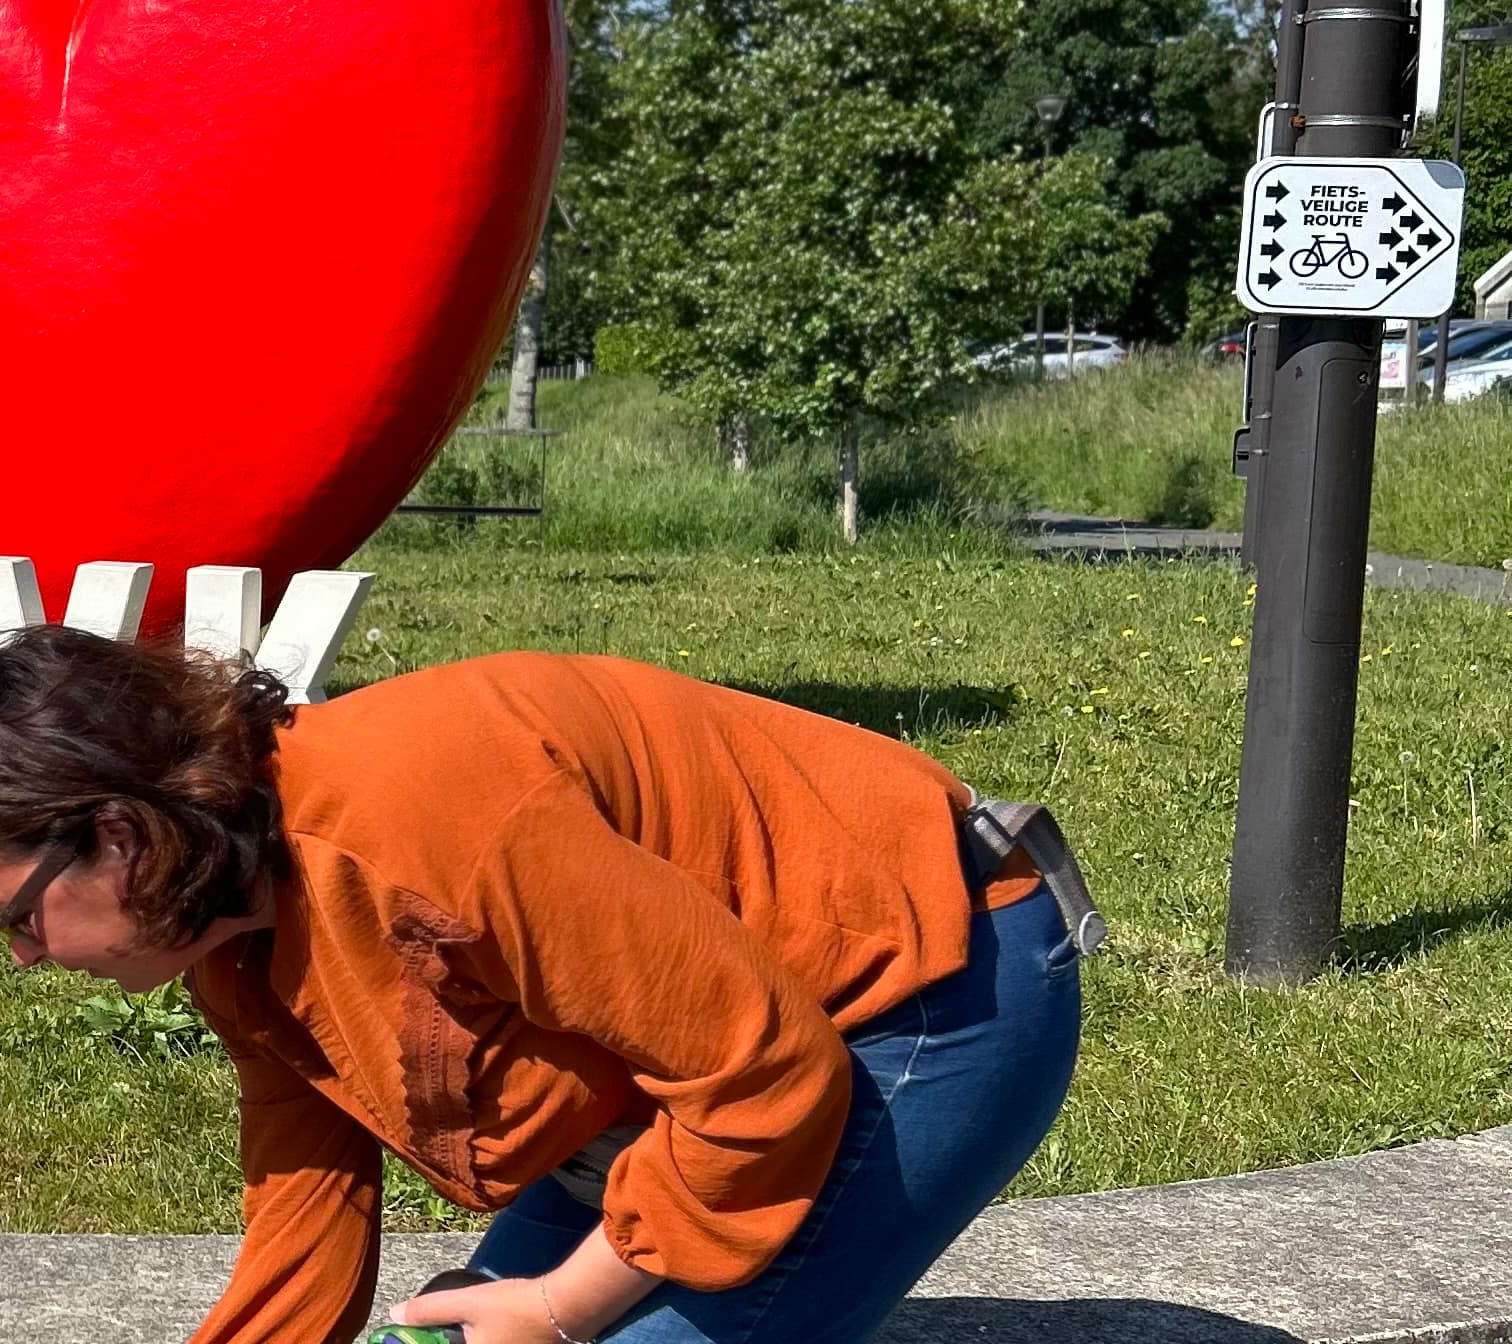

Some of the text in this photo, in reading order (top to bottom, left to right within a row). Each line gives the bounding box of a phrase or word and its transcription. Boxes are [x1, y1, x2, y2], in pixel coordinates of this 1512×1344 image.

[1311, 185, 1366, 197] FIETS-
[1300, 199, 1369, 213] VEILIGE
[1303, 214, 1364, 227] ROUTE
